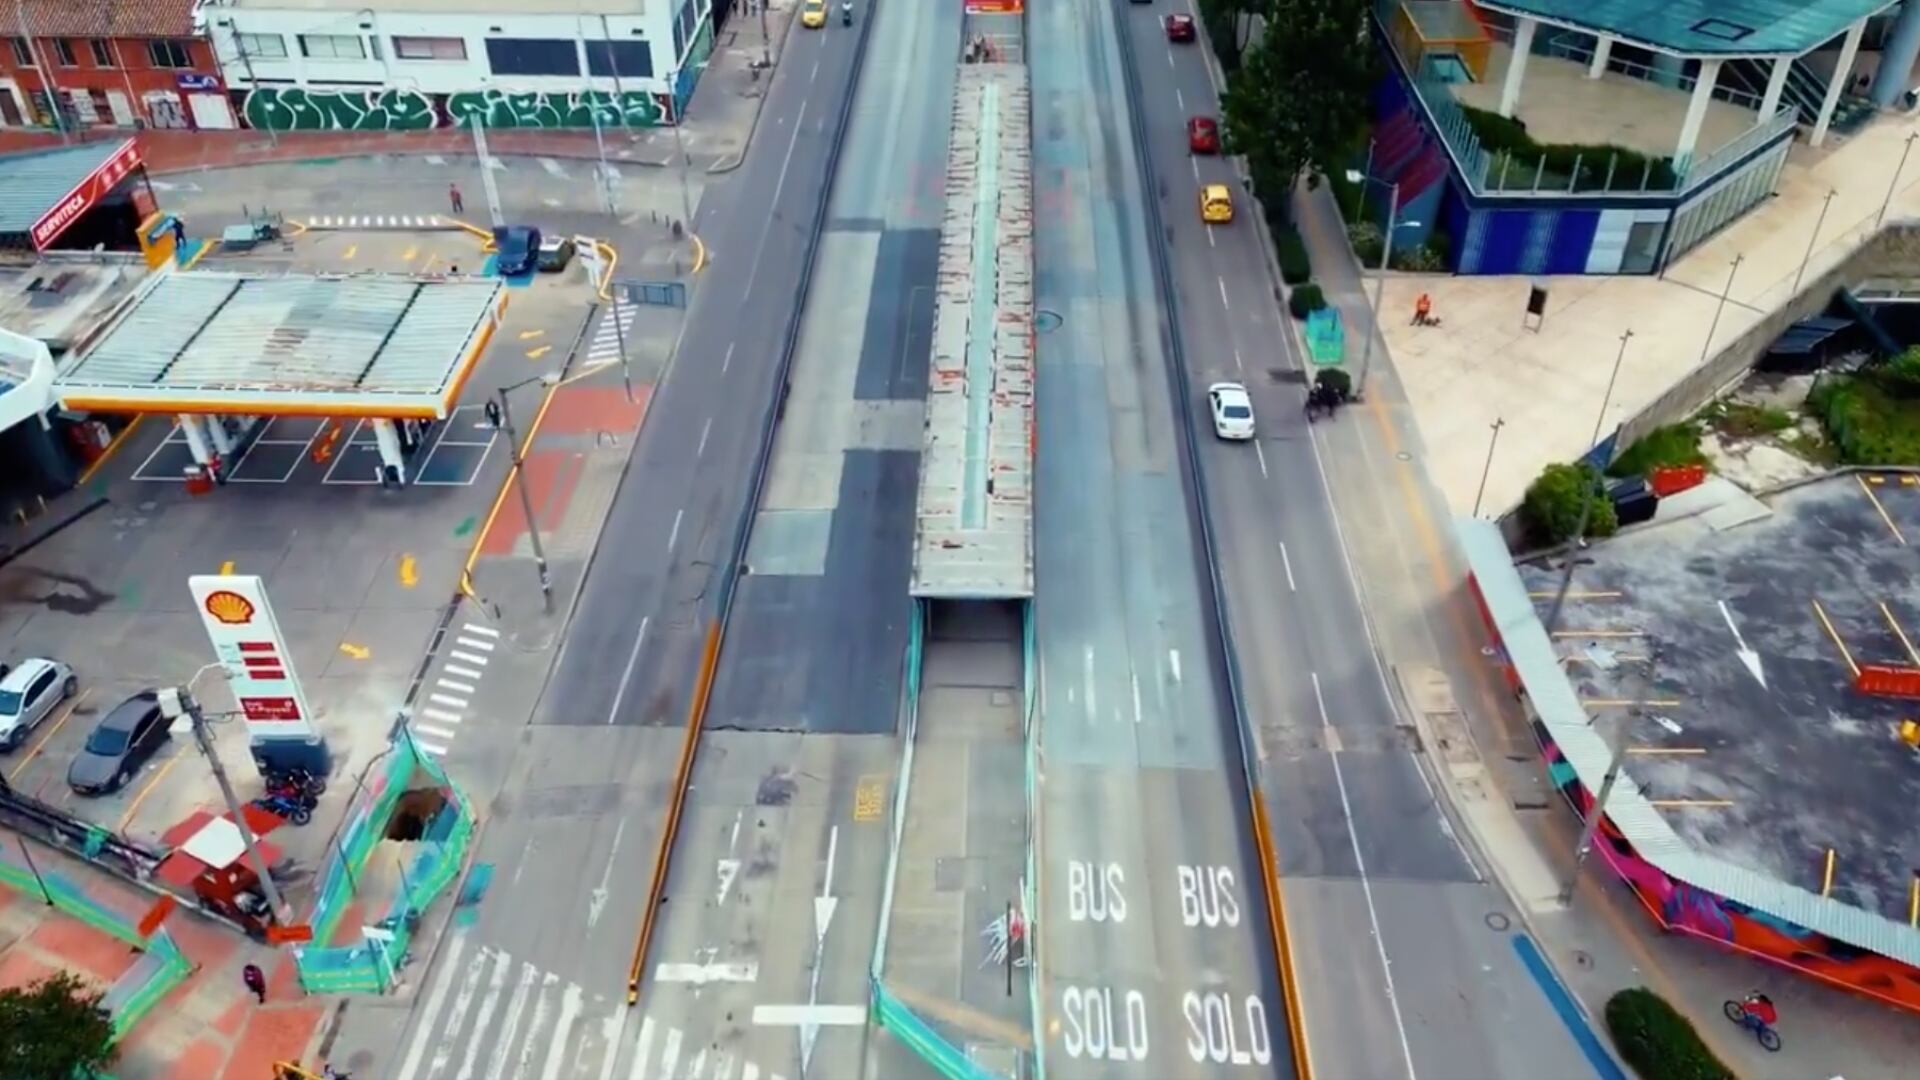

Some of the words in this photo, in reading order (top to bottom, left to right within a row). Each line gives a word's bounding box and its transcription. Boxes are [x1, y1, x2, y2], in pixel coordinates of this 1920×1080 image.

[35, 193, 85, 242] SERVITECA
[1068, 860, 1127, 923] BUS
[1177, 864, 1240, 928] BUS
[1062, 985, 1149, 1062] SOLO
[1182, 990, 1272, 1066] SOLO
